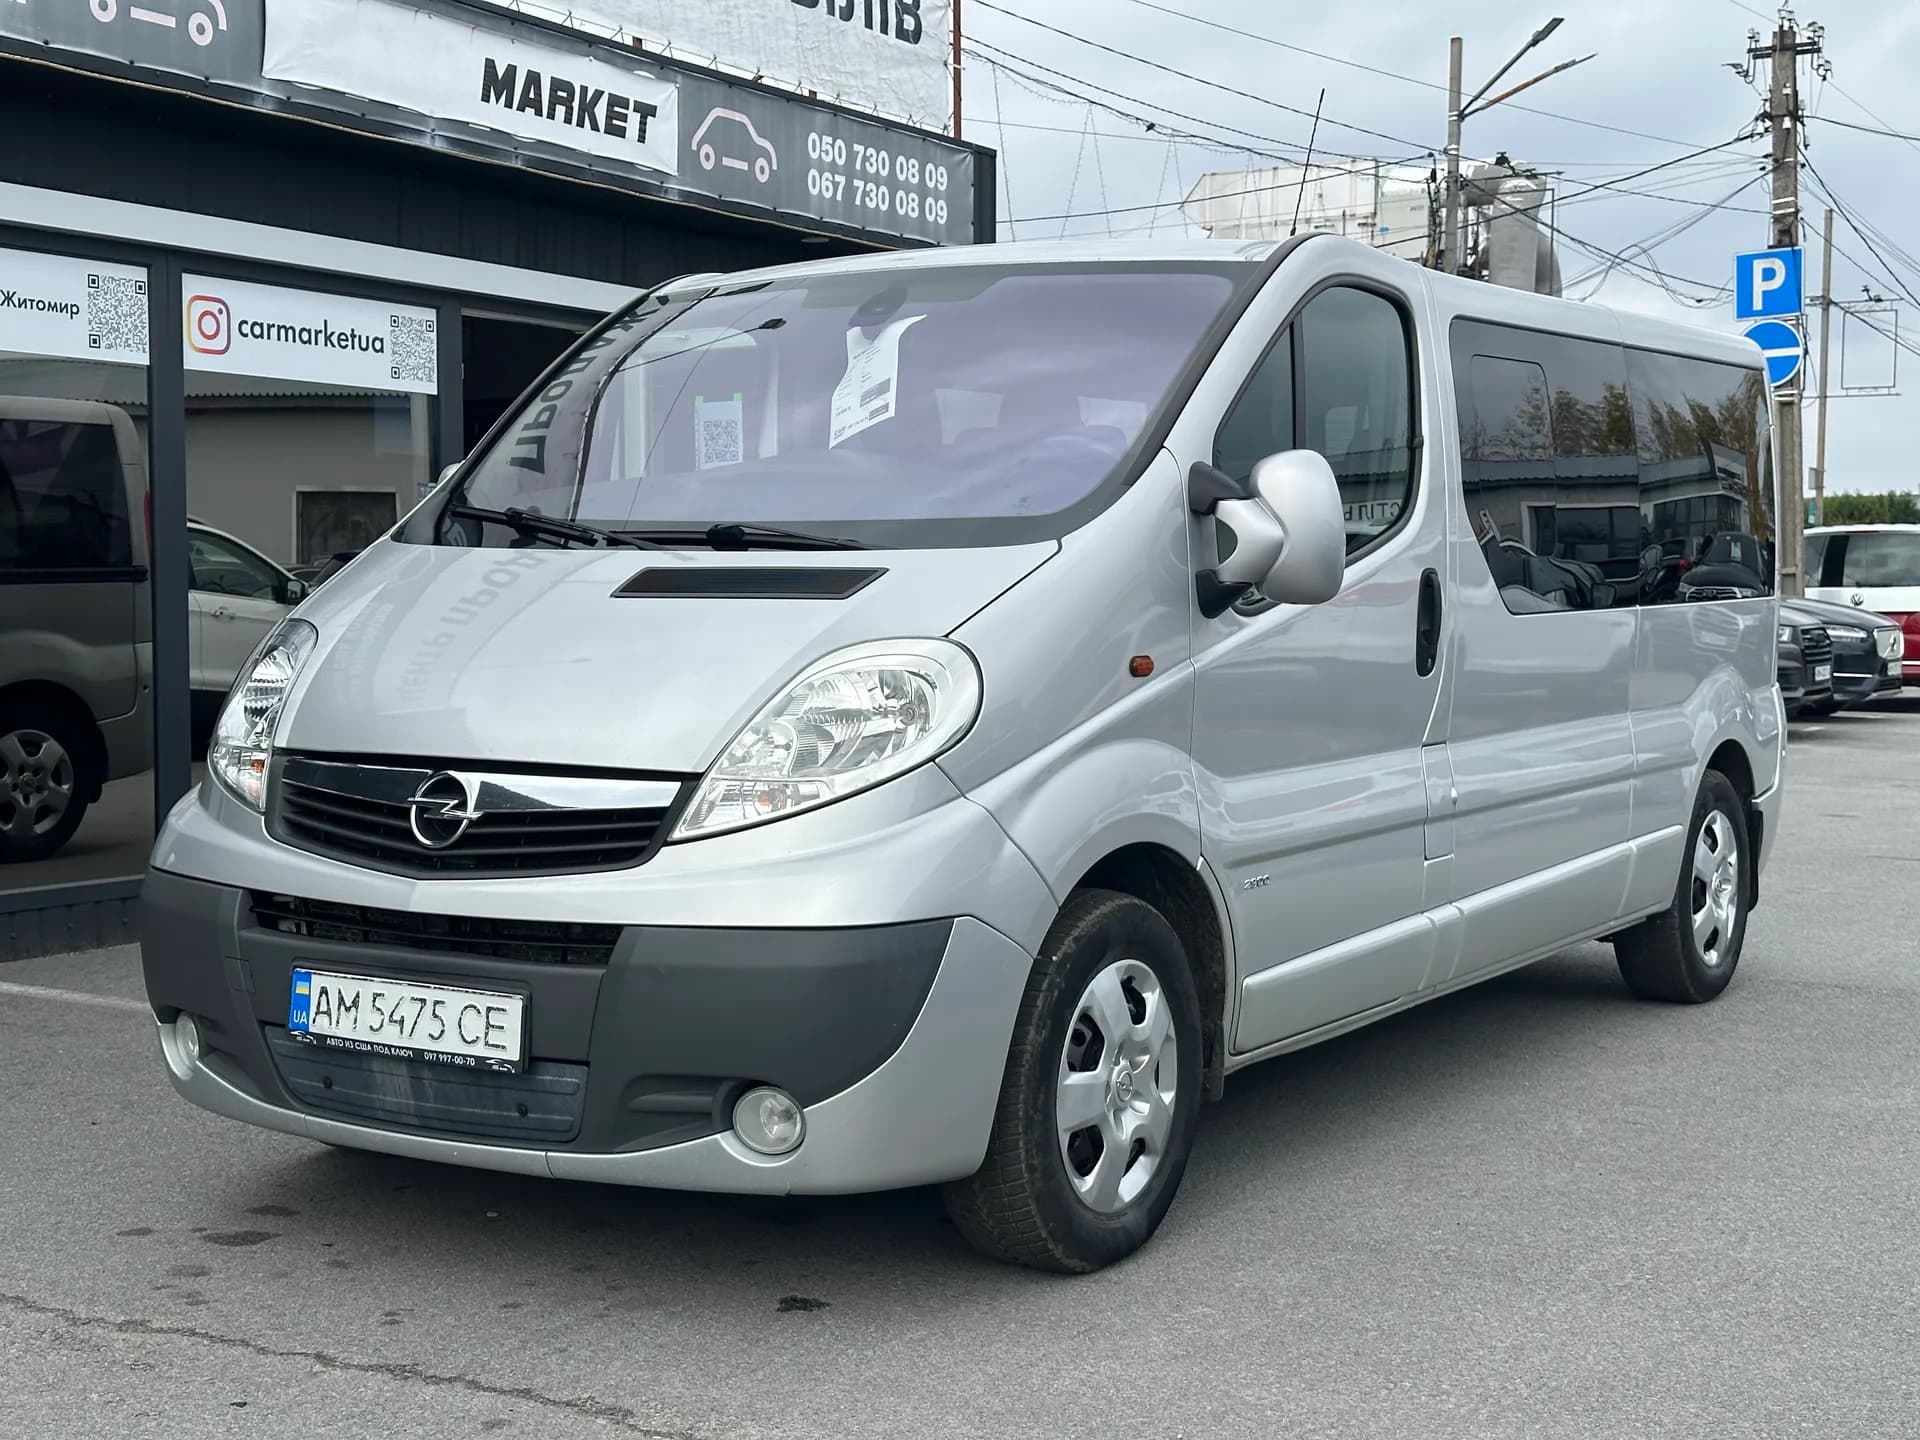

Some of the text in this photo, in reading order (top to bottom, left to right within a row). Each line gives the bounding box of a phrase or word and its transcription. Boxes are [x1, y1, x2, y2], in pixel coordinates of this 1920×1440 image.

[481, 57, 658, 144] MARKET
[807, 132, 948, 191] 050 730 08 09
[807, 168, 948, 225] 067 730 08 09
[0, 288, 80, 320] Житомир
[1752, 257, 1786, 311] P
[238, 319, 385, 354] carmarketua
[293, 1009, 308, 1025] UA
[312, 986, 508, 1050] AM 5475 CE
[326, 1037, 475, 1066] АВТО ИЗ США ПОД КЛЮЧ 097 997-00-70
